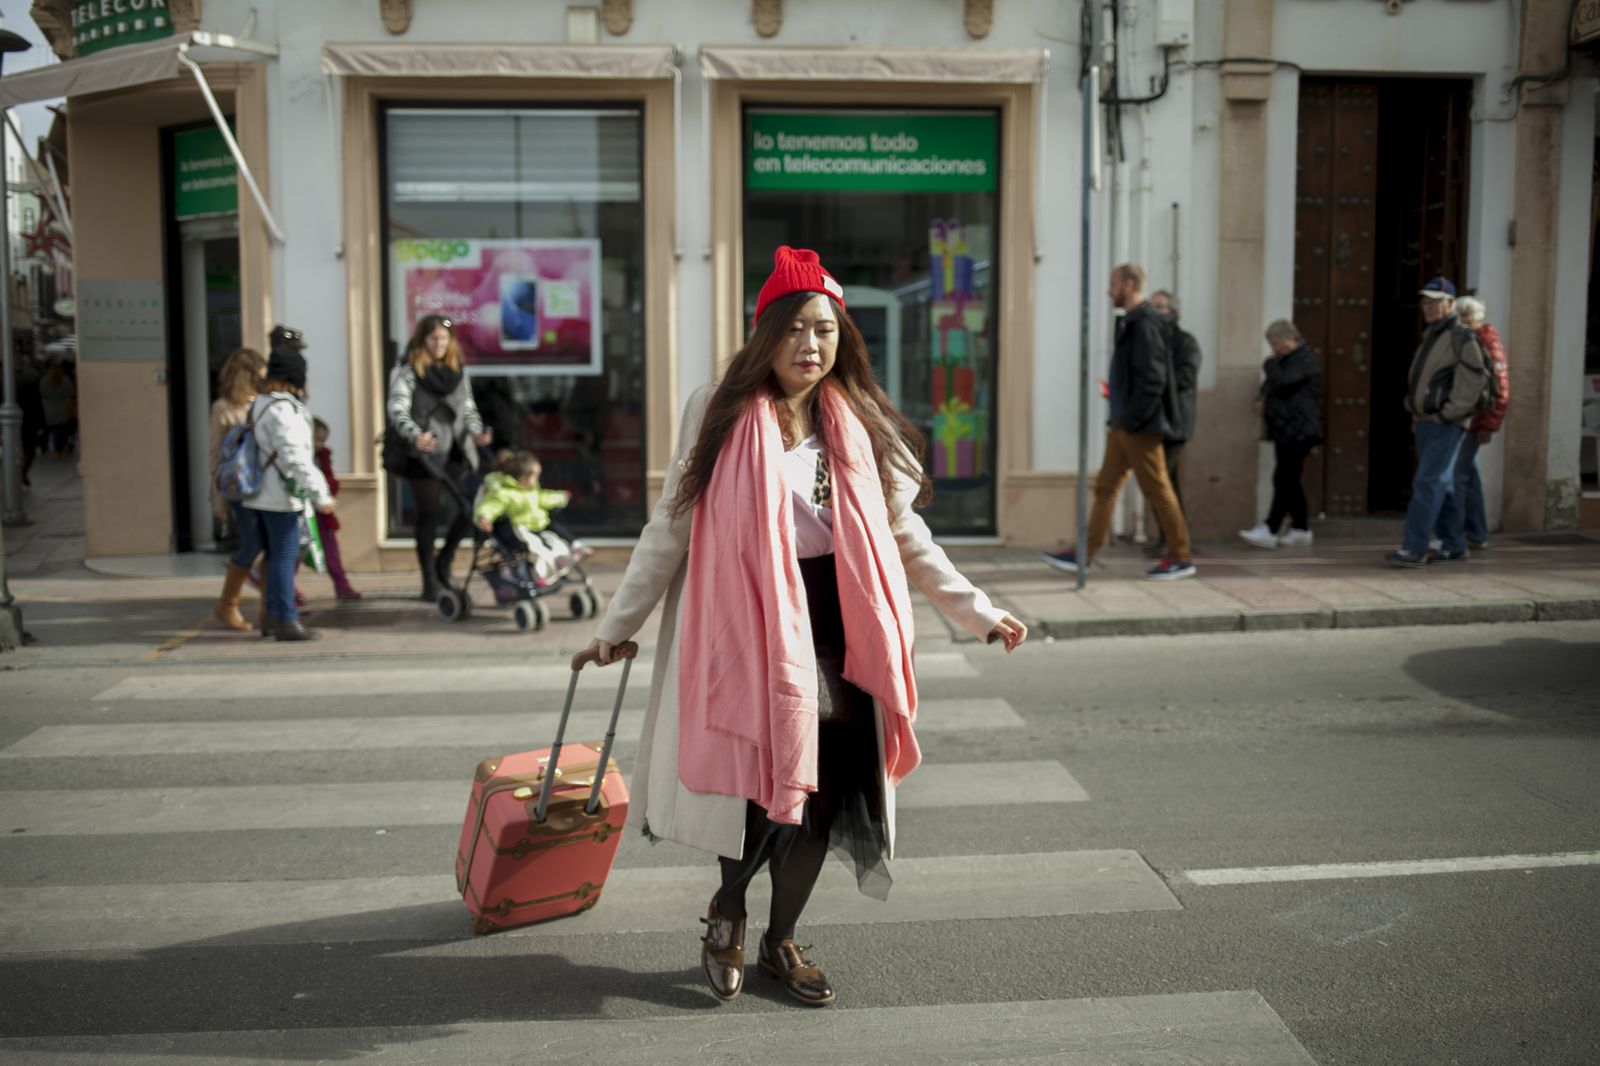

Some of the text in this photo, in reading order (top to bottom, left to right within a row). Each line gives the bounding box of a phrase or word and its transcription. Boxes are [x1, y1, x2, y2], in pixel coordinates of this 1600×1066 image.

[754, 131, 918, 152] lo tenemos todo
[754, 154, 986, 175] en telecomunicaciones
